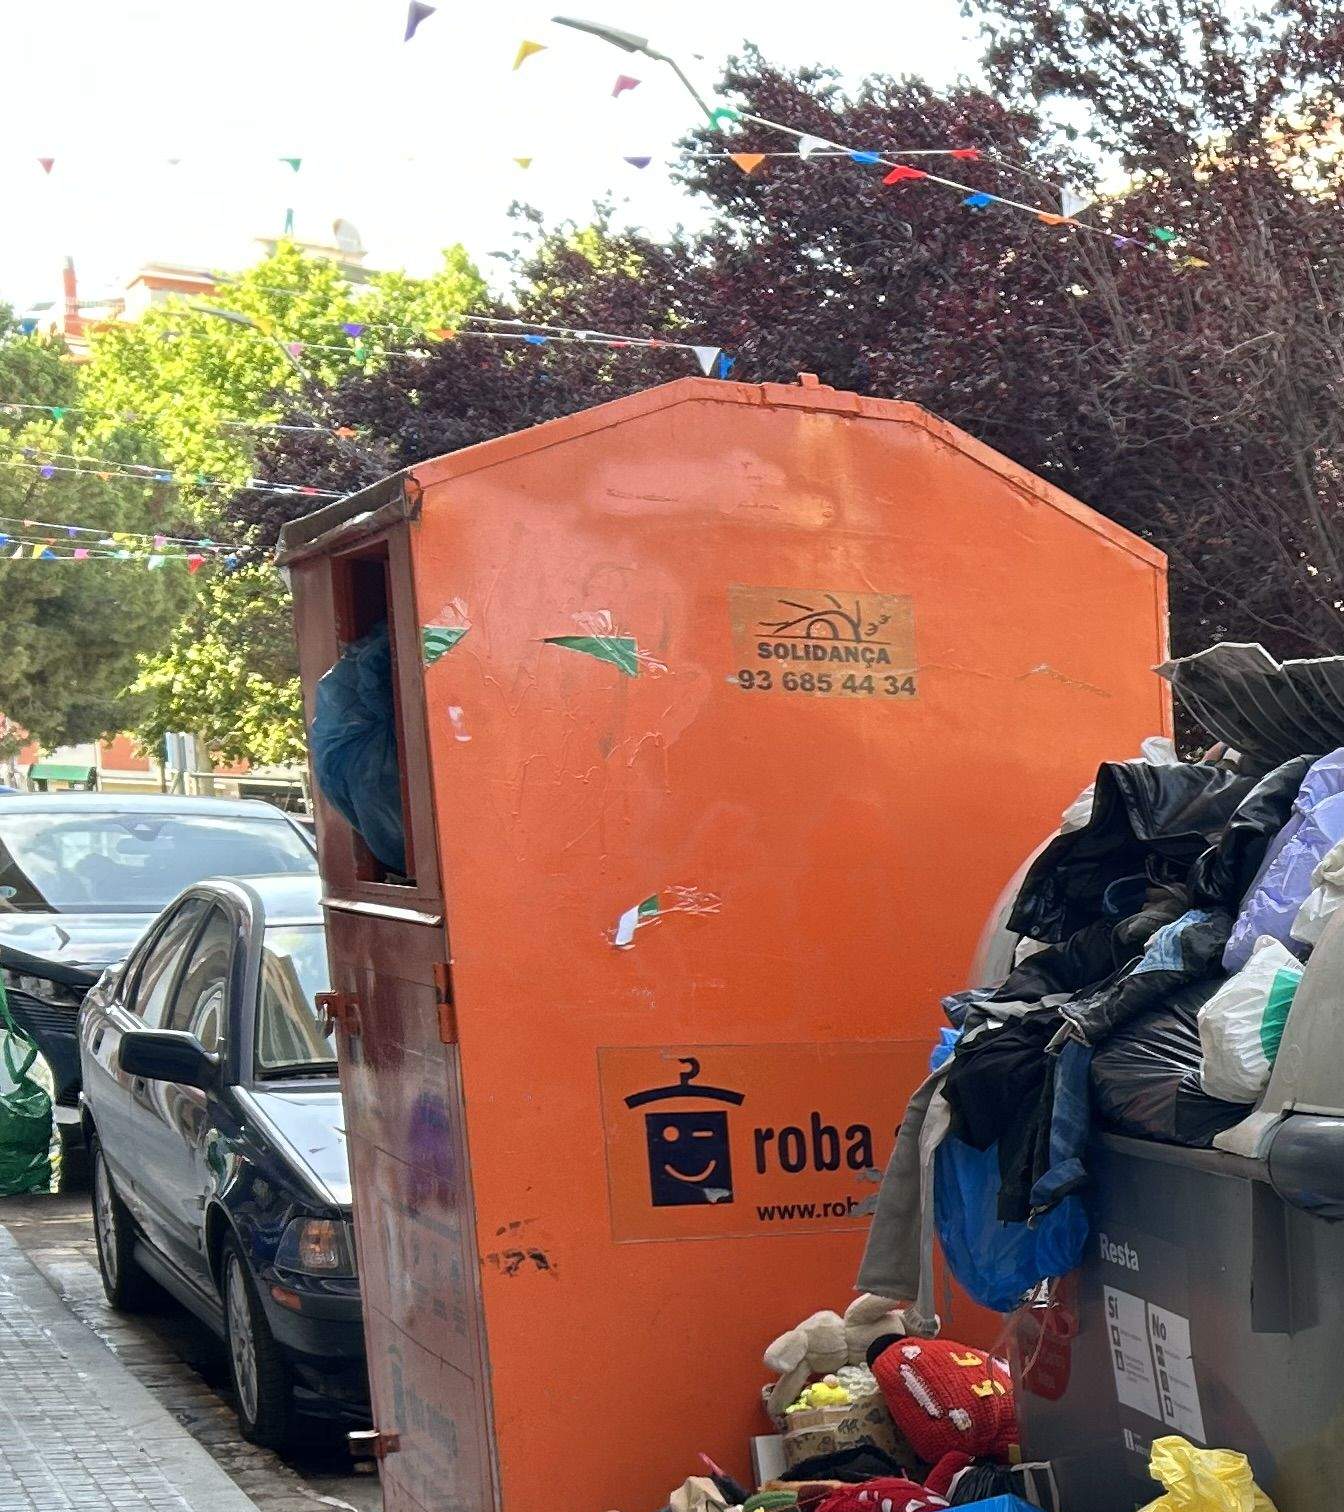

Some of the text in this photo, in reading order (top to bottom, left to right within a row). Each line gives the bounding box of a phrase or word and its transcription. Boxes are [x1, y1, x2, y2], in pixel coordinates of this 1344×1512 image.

[757, 641, 891, 668] SOLIDANÇA
[738, 669, 916, 696] 93 685 44 34
[753, 1111, 874, 1174] roba
[1100, 1232, 1140, 1272] Resta
[1152, 1313, 1167, 1341] No
